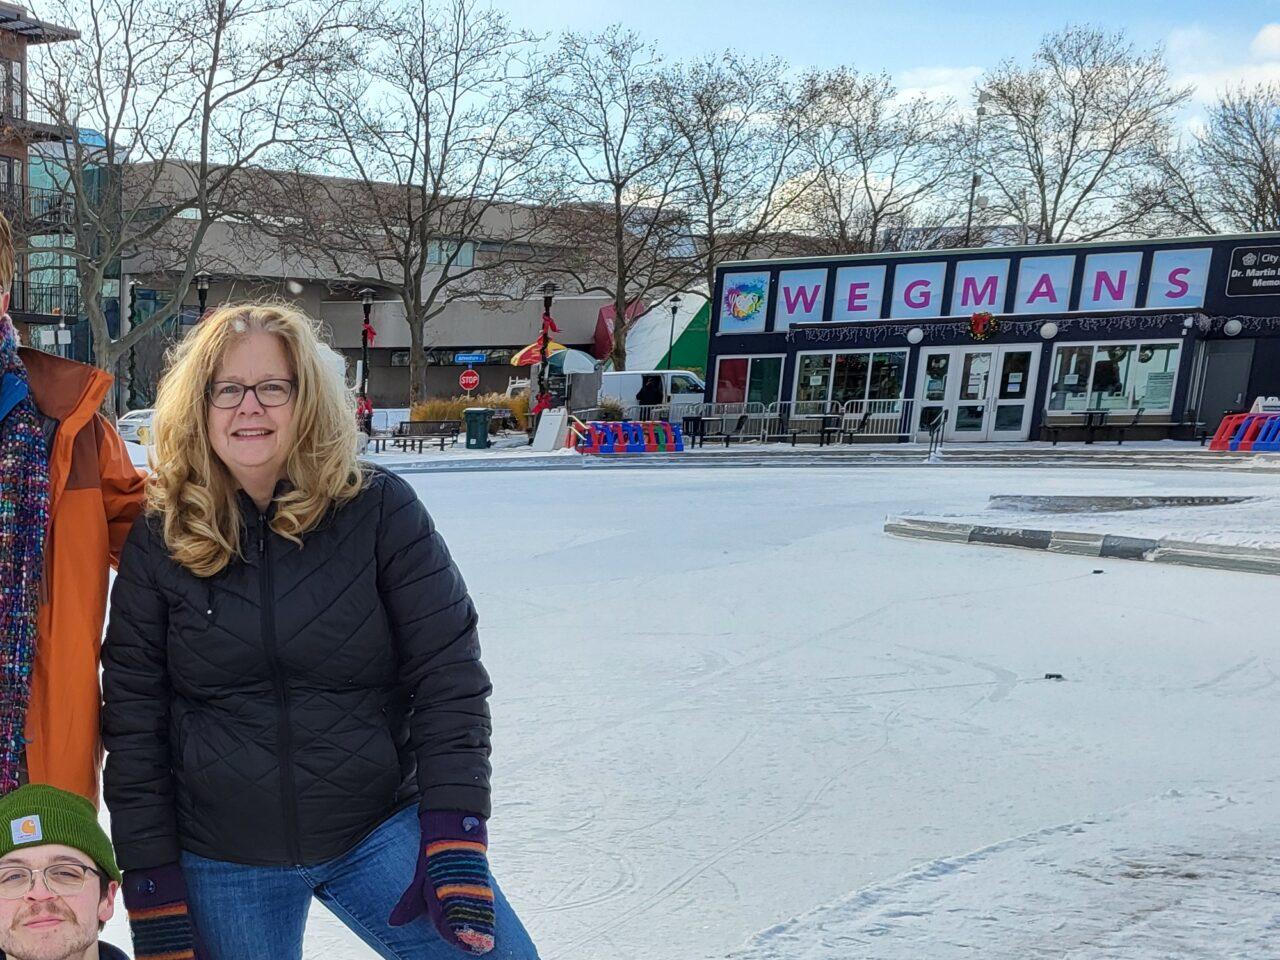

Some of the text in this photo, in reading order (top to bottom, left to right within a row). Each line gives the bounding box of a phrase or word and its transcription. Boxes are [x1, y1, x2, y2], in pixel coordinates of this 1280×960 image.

[1261, 253, 1279, 264] City
[1231, 269, 1244, 278] Dr.
[1245, 267, 1276, 277] Martin
[1252, 278, 1280, 287] Memo
[782, 266, 1192, 316] WEGMANS
[461, 376, 478, 384] STOP
